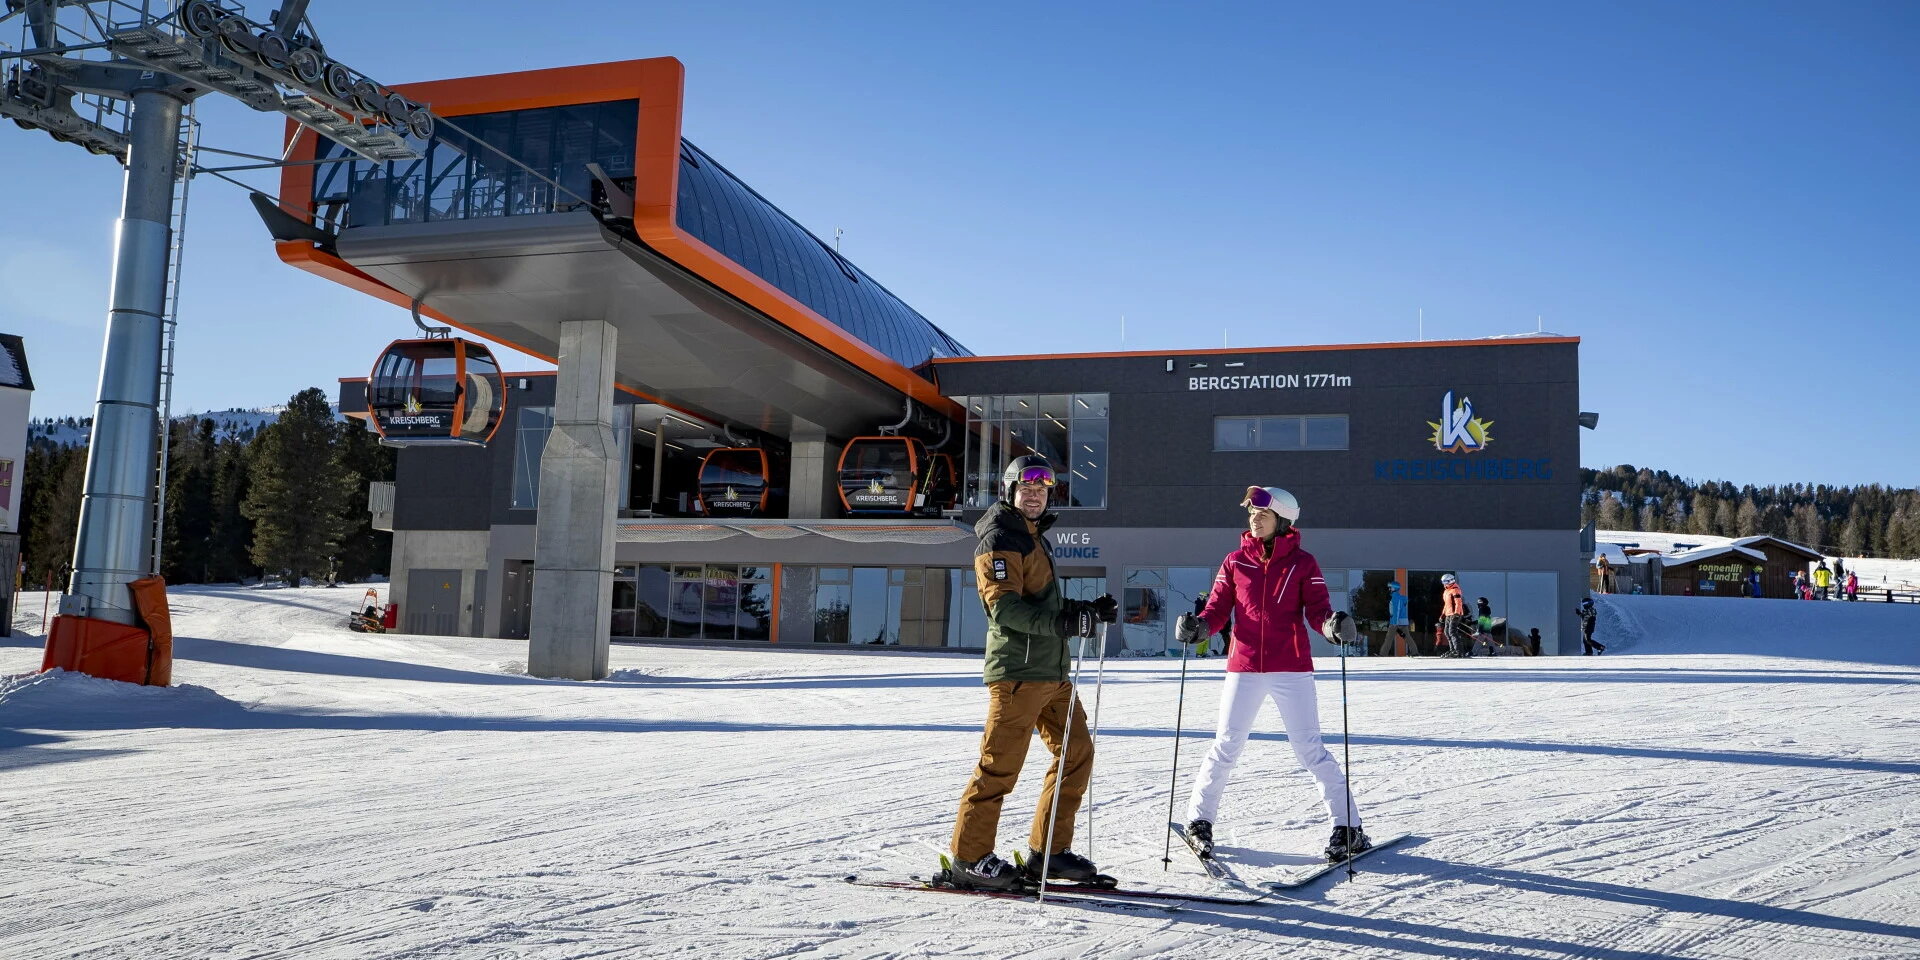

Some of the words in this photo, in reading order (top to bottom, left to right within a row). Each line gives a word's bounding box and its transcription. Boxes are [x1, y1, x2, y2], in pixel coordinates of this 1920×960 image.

[1189, 374, 1299, 391] BERGSTATION
[1303, 373, 1352, 388] 1771m
[390, 416, 440, 424] KREISCHBERG
[1374, 458, 1553, 481] KREISCHBERG
[1056, 533, 1078, 545] WC
[1081, 533, 1091, 545] &
[1054, 547, 1100, 559] OUNGE
[1698, 563, 1742, 573] sonnenlift
[1714, 572, 1730, 580] und
